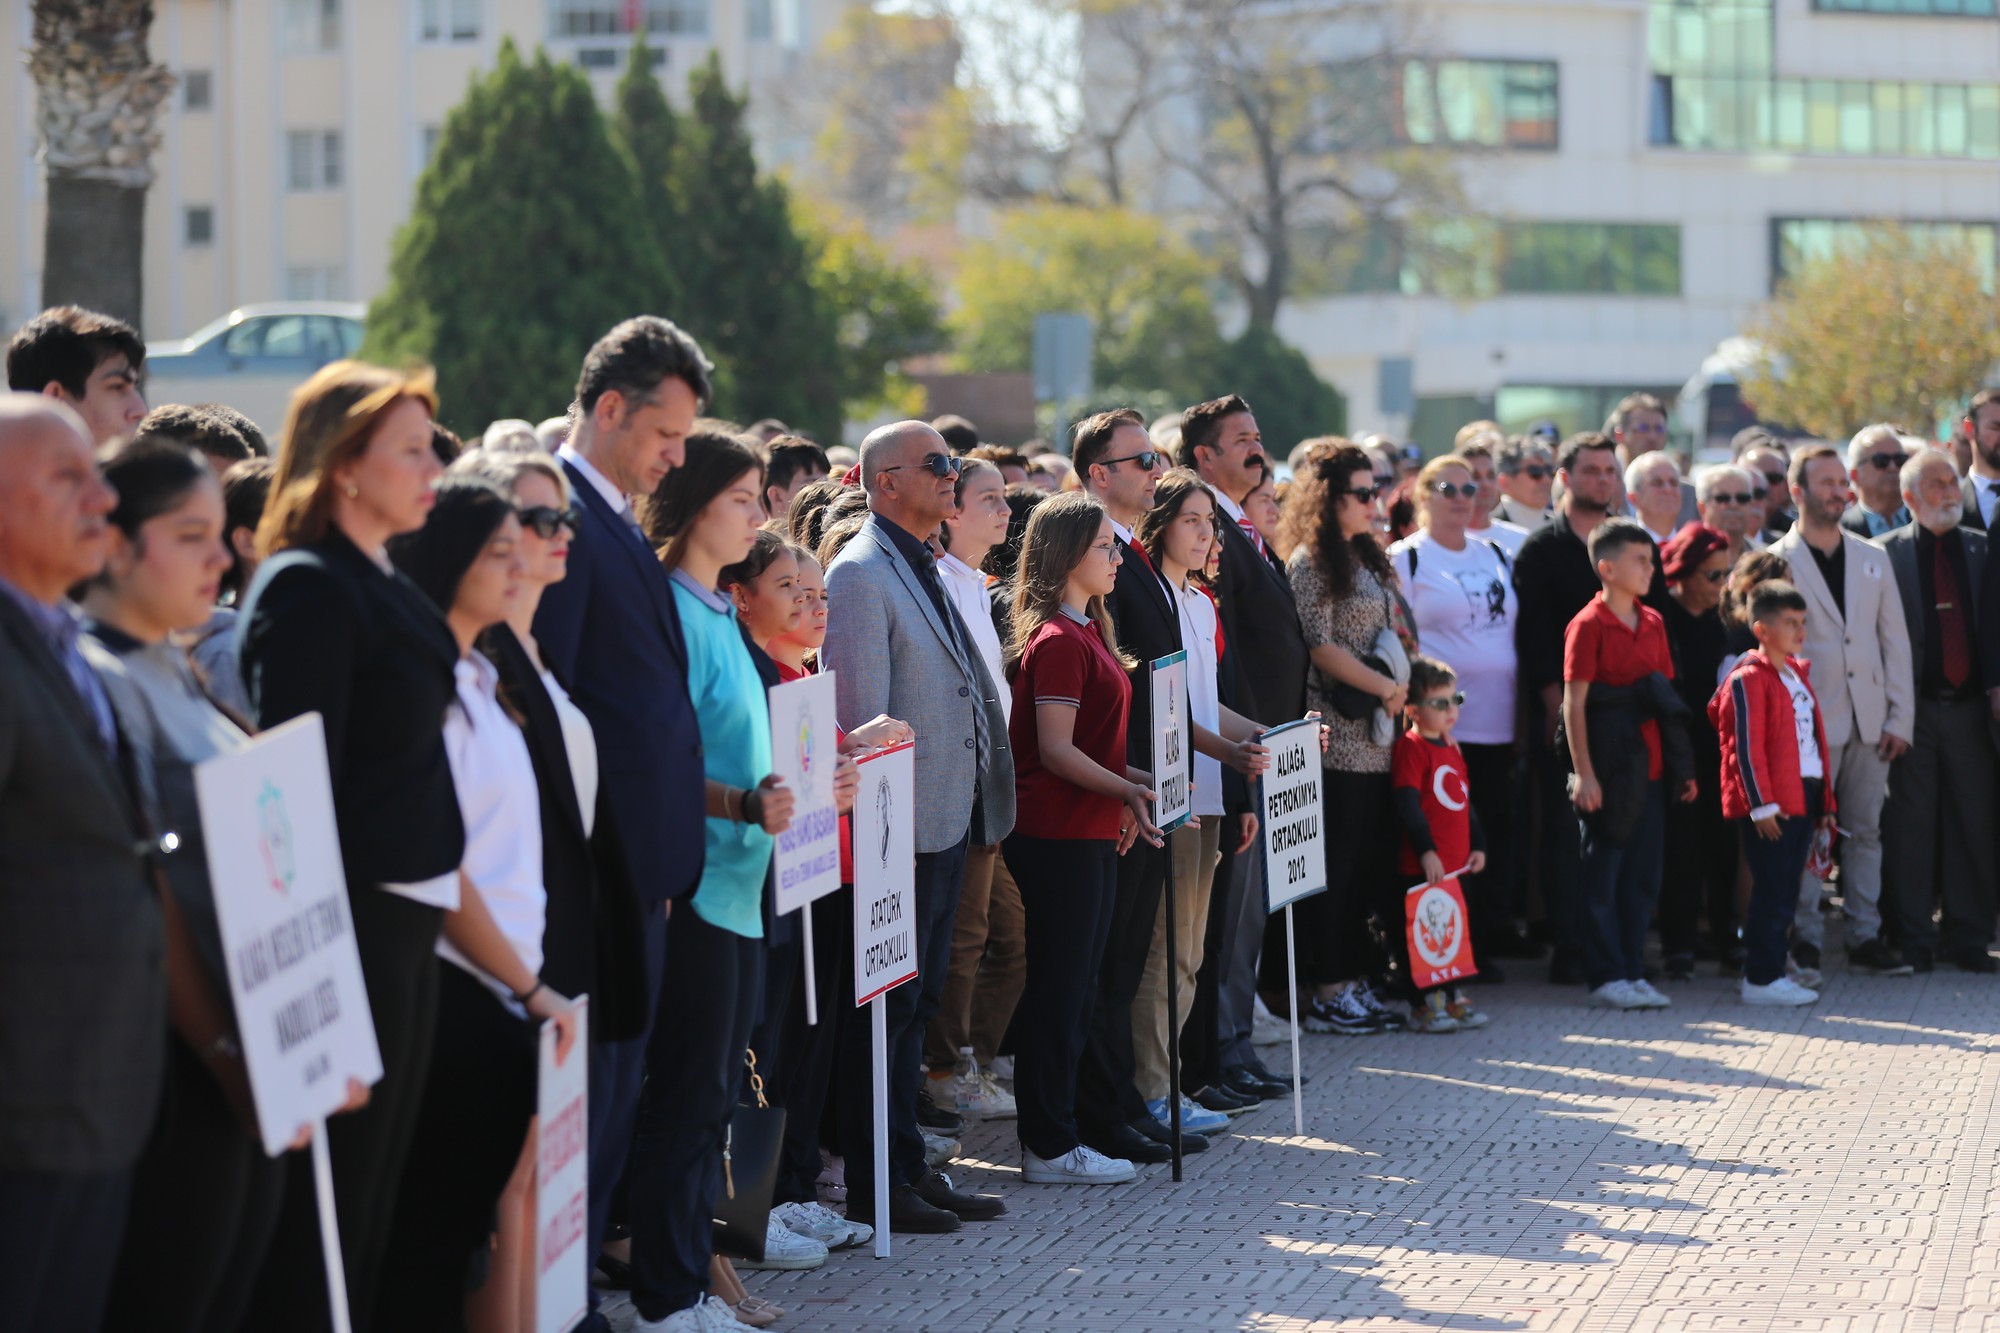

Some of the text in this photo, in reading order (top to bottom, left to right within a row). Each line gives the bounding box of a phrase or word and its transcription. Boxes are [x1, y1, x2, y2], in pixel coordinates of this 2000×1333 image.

[1277, 743, 1306, 778] ALİAĞA
[1269, 780, 1318, 820] PETROKİMYA
[1272, 814, 1318, 854] ORTAOKULU
[1288, 855, 1306, 884] 2012
[870, 889, 902, 932] ATATÜRK
[865, 930, 908, 978] ORTAOKULU
[1430, 966, 1461, 984] ATA
